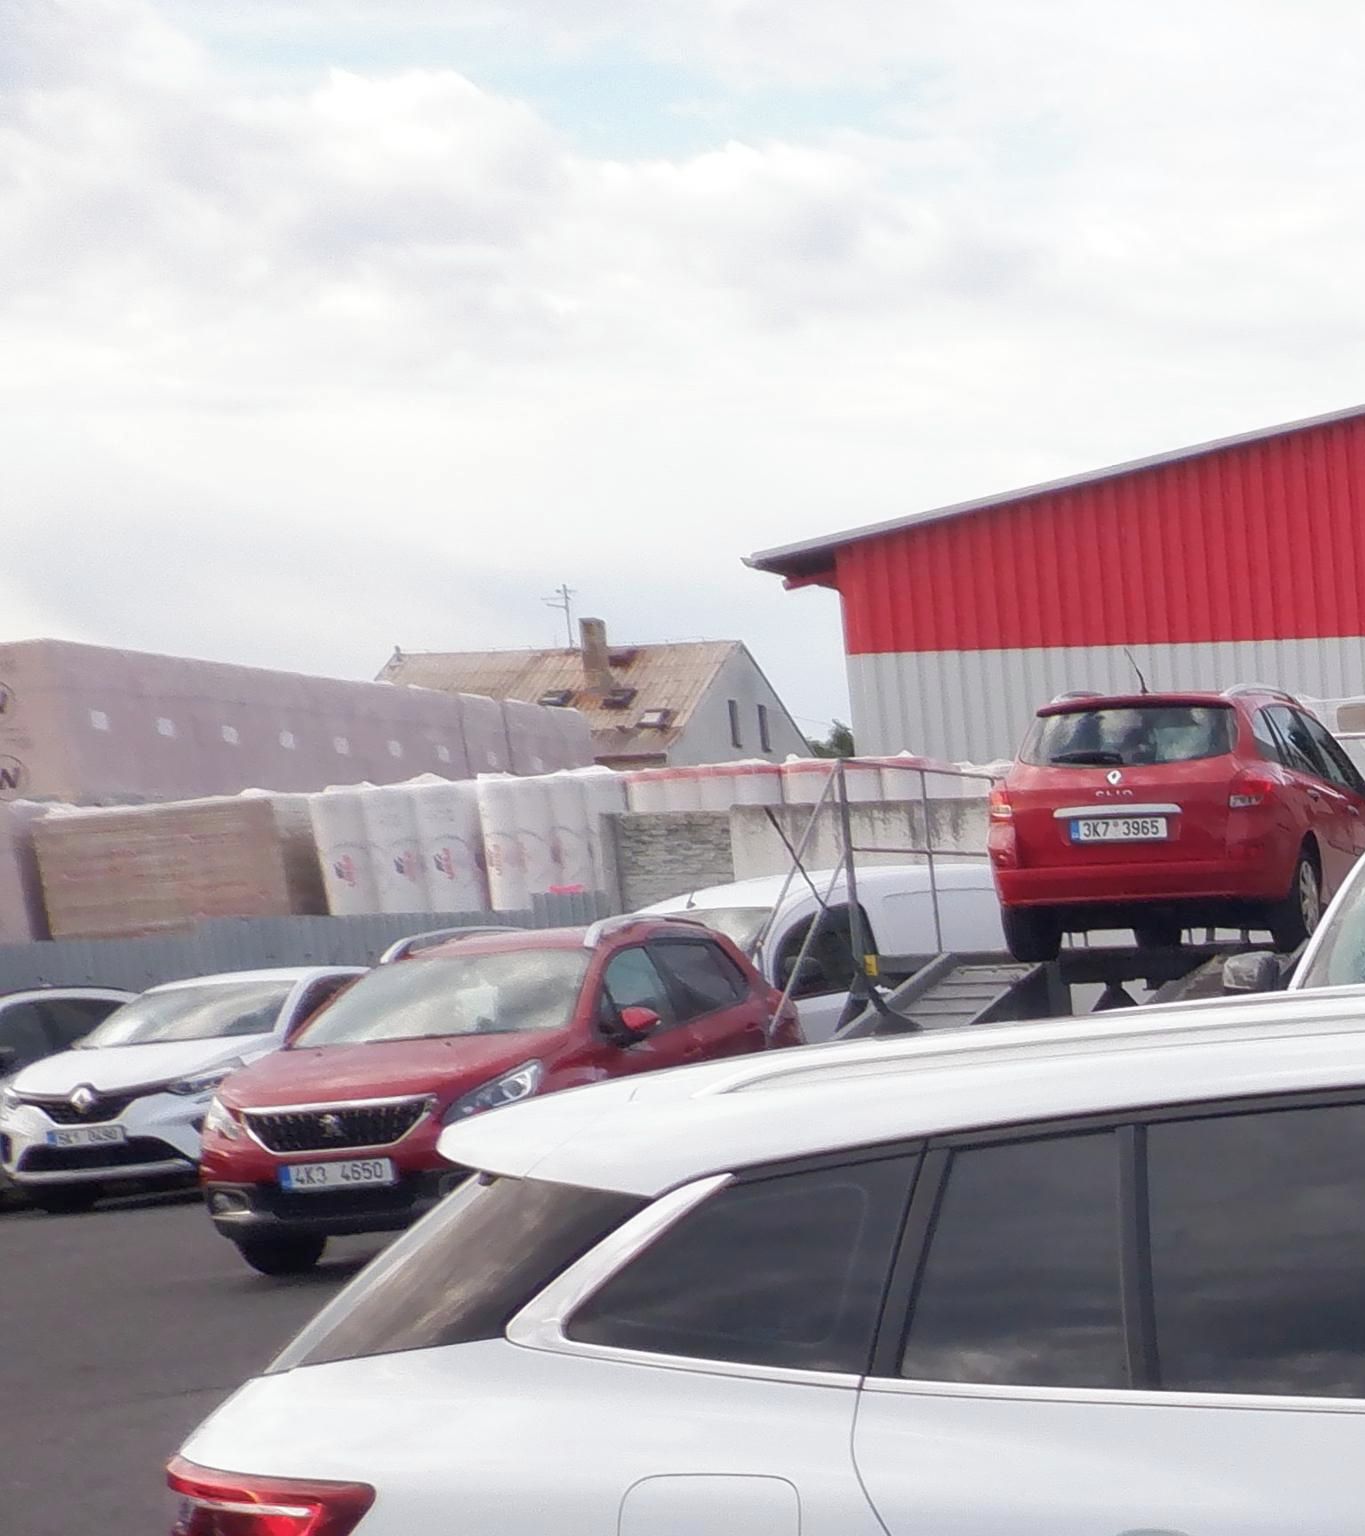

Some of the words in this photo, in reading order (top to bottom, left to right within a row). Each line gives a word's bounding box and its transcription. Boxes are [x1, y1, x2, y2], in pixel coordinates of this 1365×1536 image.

[1083, 821, 1111, 838] 3K7
[1121, 819, 1160, 836] 3965
[340, 1161, 384, 1181] 4650
